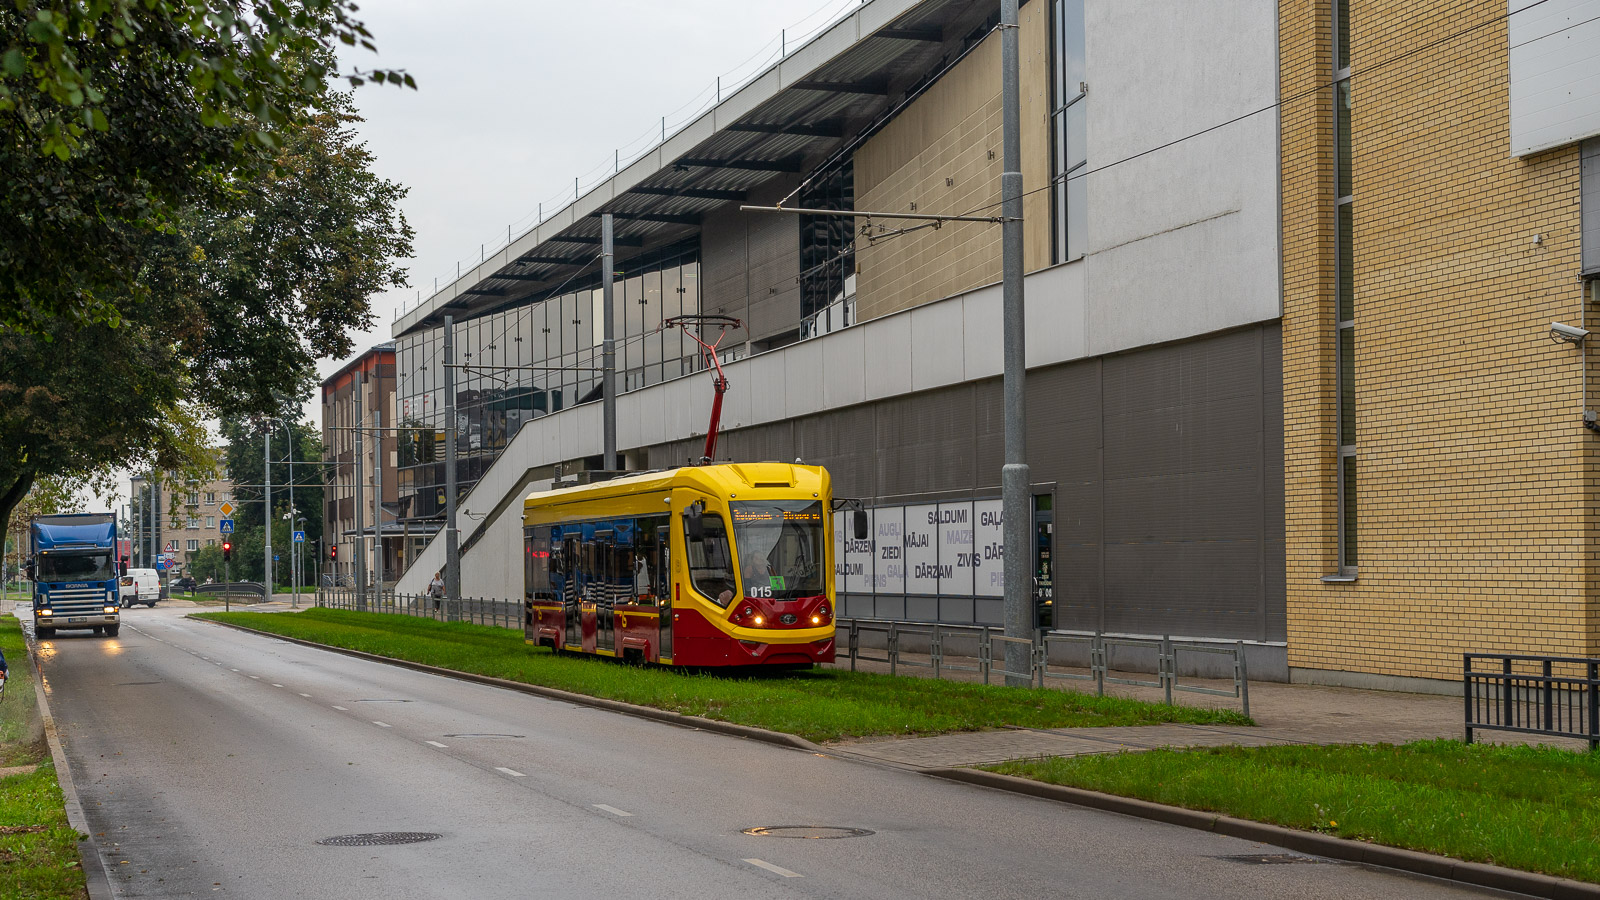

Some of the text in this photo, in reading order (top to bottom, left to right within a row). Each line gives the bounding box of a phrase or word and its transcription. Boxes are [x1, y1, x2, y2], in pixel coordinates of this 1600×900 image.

[928, 509, 967, 524] SALDUMI
[879, 522, 902, 540] AUGĻI
[947, 530, 974, 545] MAIZE
[903, 532, 929, 548] MĀJAI
[882, 546, 901, 560] ZIEDI
[985, 545, 1004, 560] DĀR
[957, 553, 981, 568] ZIVIS
[915, 565, 953, 579] DĀRZAM
[991, 571, 1004, 587] PIE
[864, 573, 887, 588] PIENS
[750, 586, 772, 598] 015
